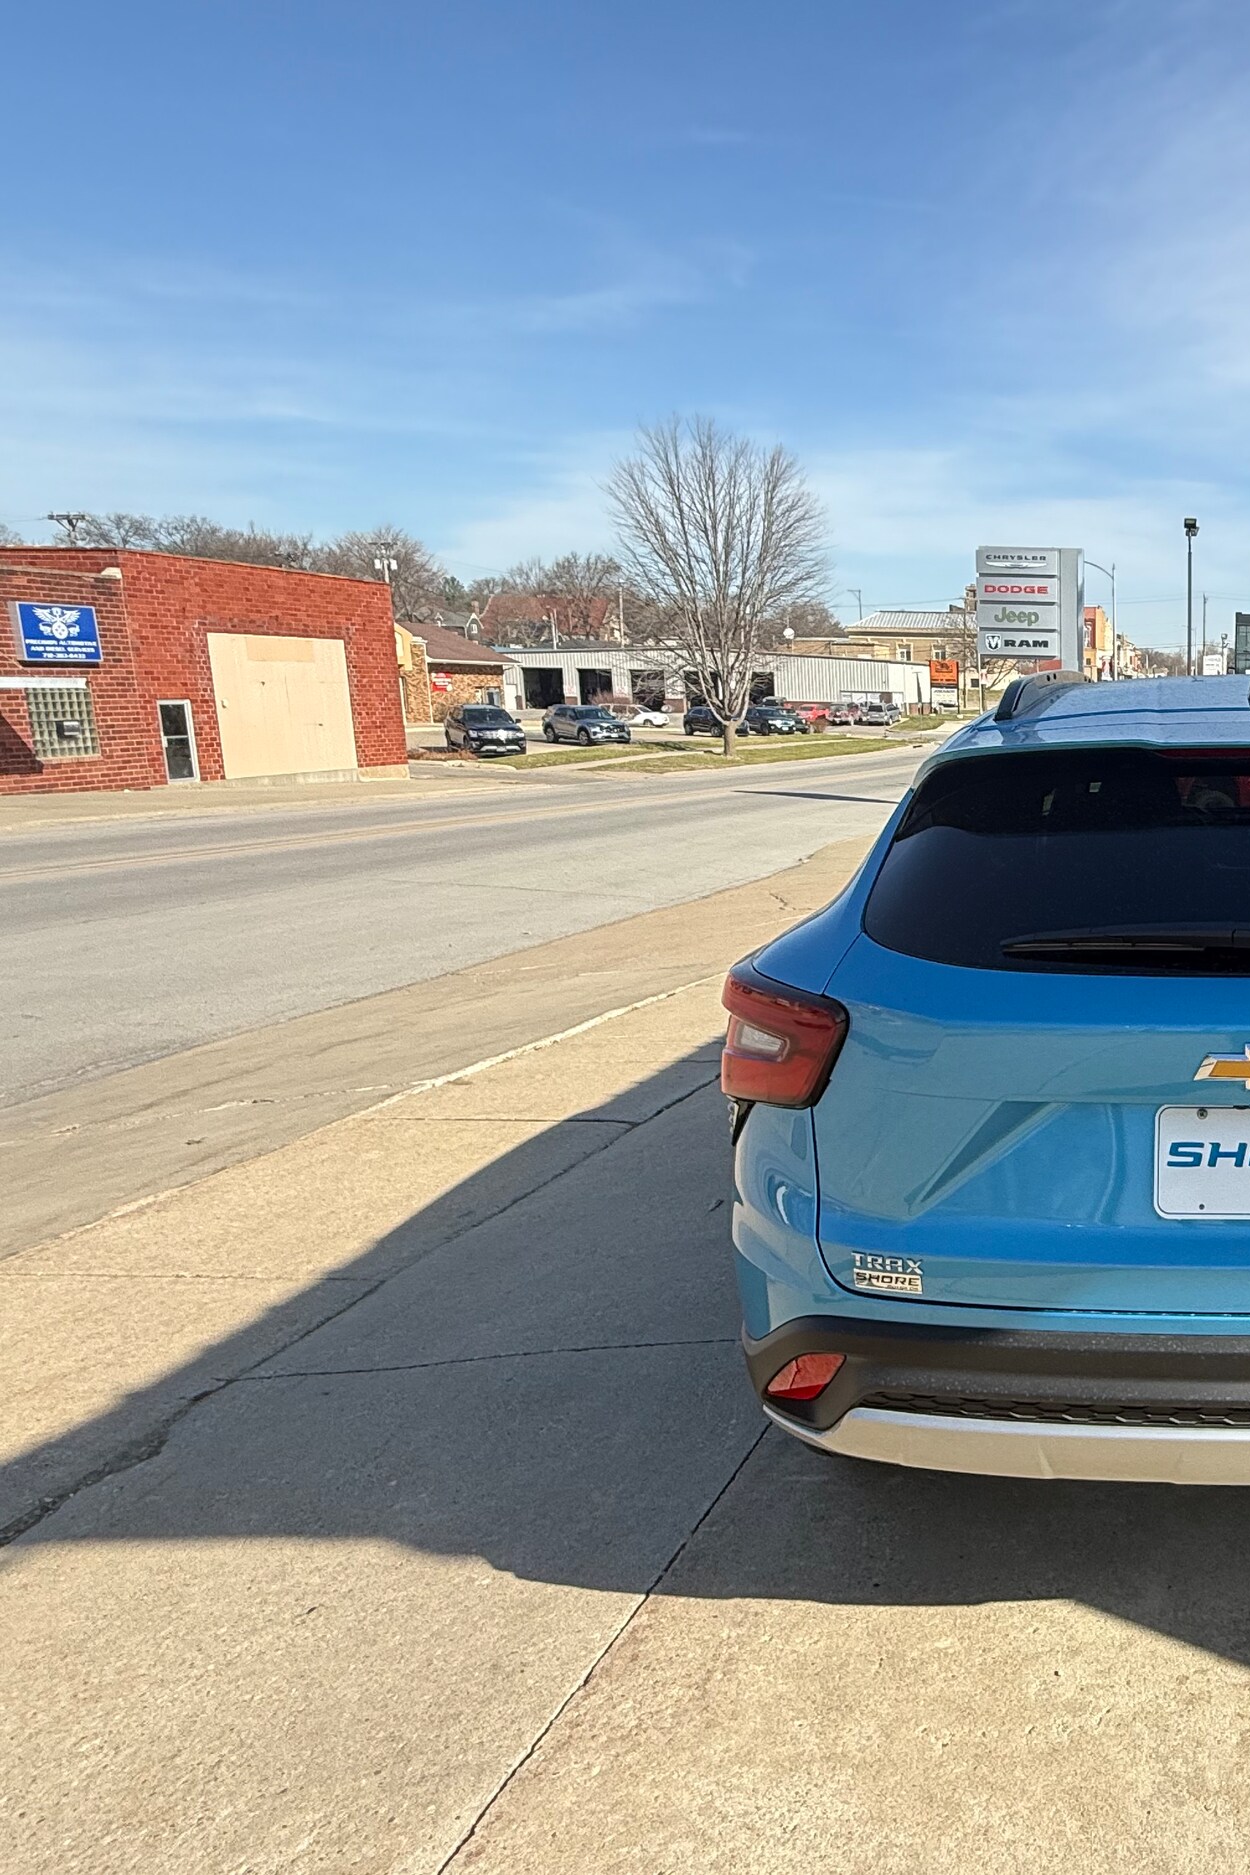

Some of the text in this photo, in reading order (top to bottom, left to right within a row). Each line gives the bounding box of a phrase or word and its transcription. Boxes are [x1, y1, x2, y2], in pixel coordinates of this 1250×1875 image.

[984, 585, 1049, 594] DODGE
[994, 607, 1040, 627] Jeep
[1004, 639, 1049, 648] RAM
[851, 1251, 924, 1275] TRAX
[856, 1272, 920, 1287] SHORE
